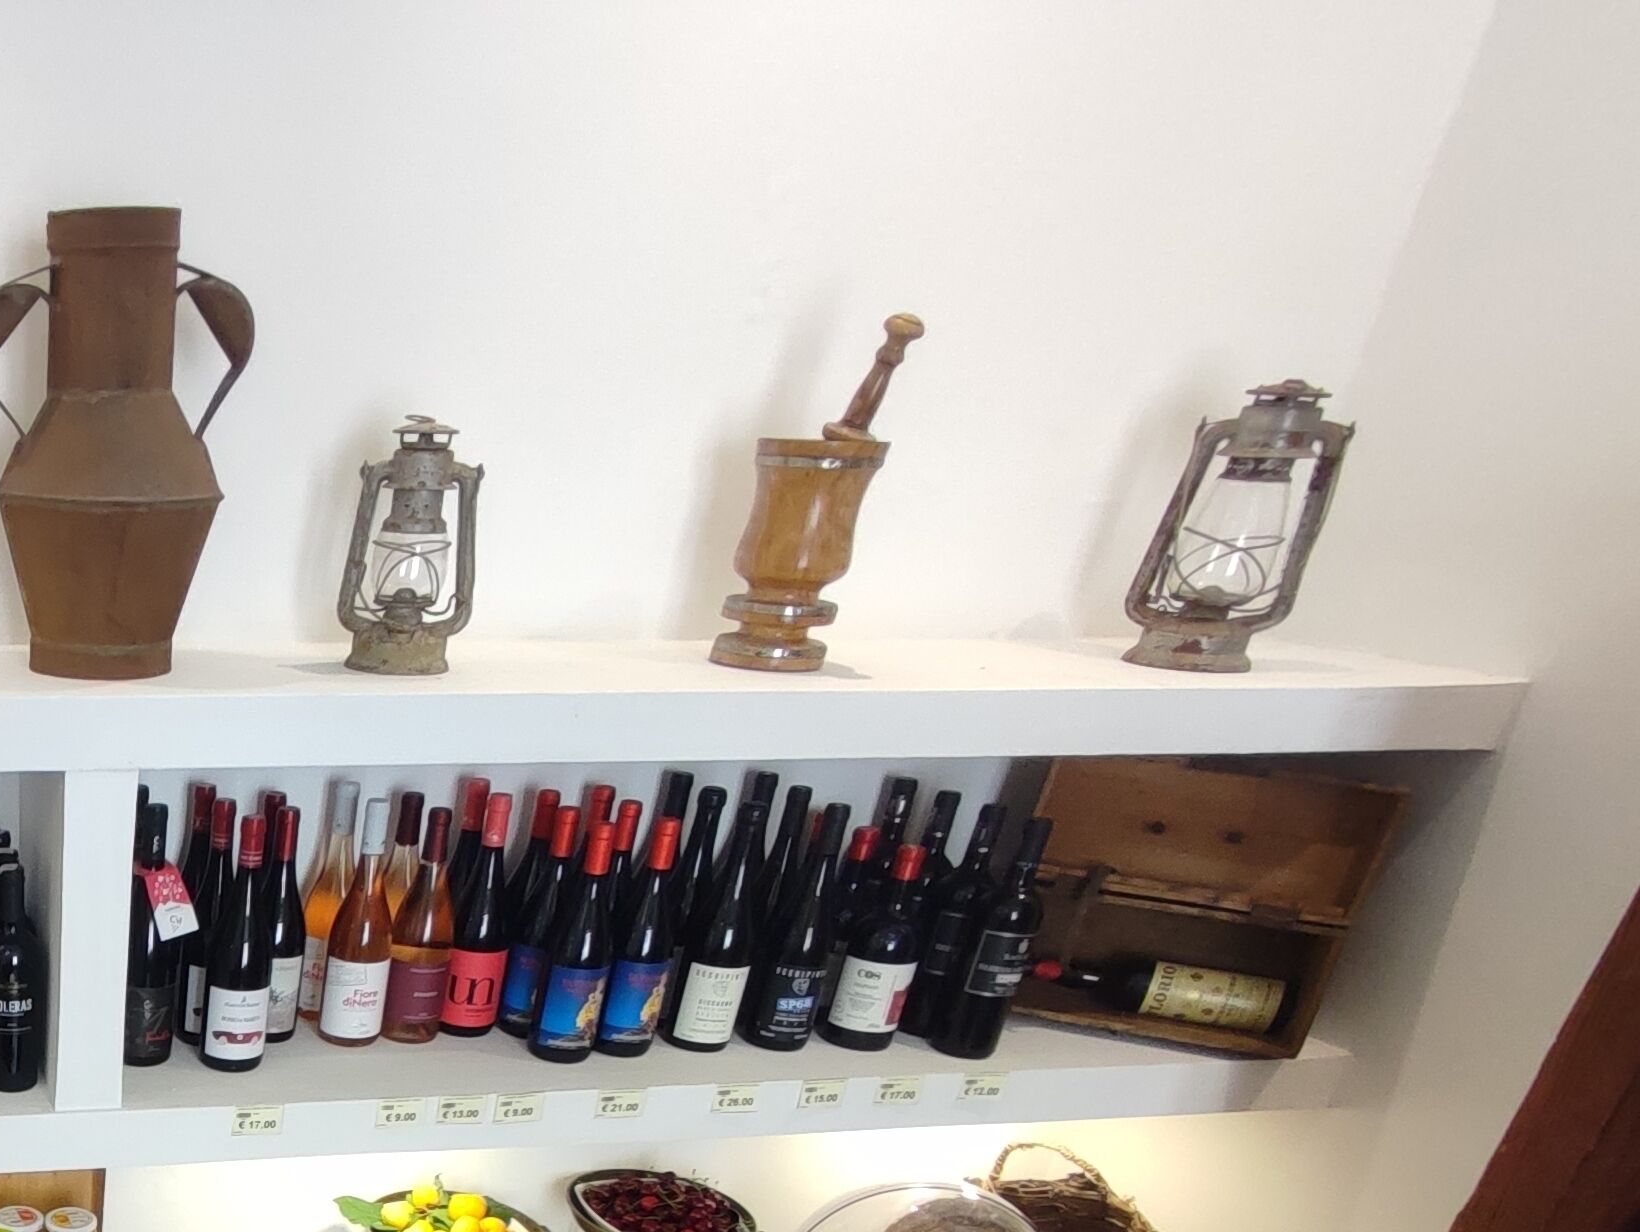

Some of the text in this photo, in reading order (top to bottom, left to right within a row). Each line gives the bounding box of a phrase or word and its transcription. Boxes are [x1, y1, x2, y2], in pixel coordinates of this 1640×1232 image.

[353, 989, 379, 999] Fiore
[880, 1091, 888, 1100] €
[964, 1087, 971, 1095] €
[718, 1099, 726, 1107] €
[805, 1095, 812, 1104] €
[602, 1104, 639, 1113] € 21.00
[386, 1112, 417, 1122] € 9.00
[442, 1110, 479, 1119] € 13.00
[503, 1109, 510, 1118] €
[238, 1120, 277, 1129] € 17.00
